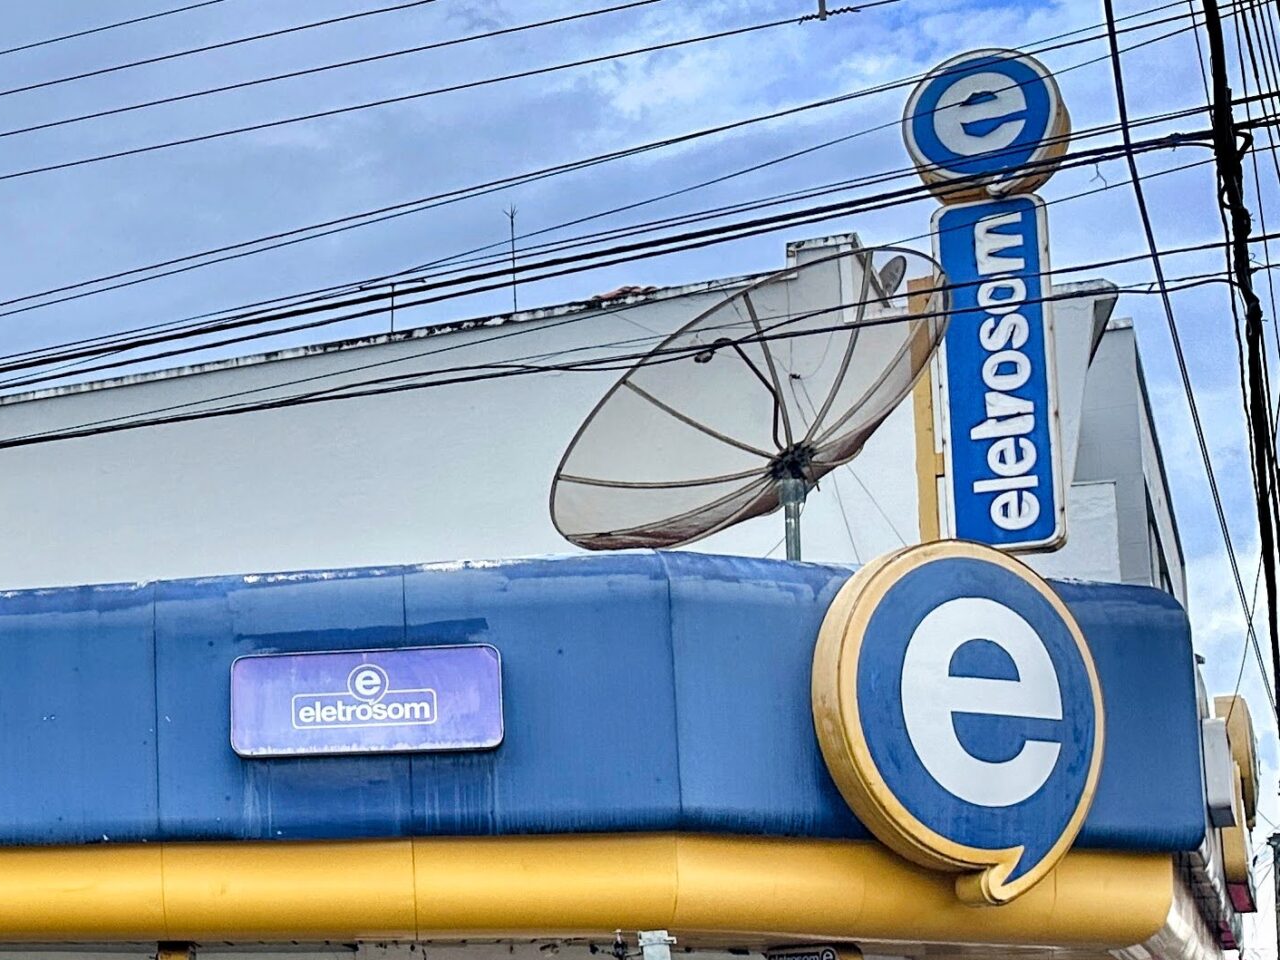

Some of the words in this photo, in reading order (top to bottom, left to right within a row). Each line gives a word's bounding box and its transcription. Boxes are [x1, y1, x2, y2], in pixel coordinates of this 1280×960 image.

[933, 71, 1027, 155] e
[971, 211, 1040, 531] eletrosom
[299, 700, 431, 723] eletrosom
[355, 670, 381, 696] e
[900, 597, 1063, 808] e
